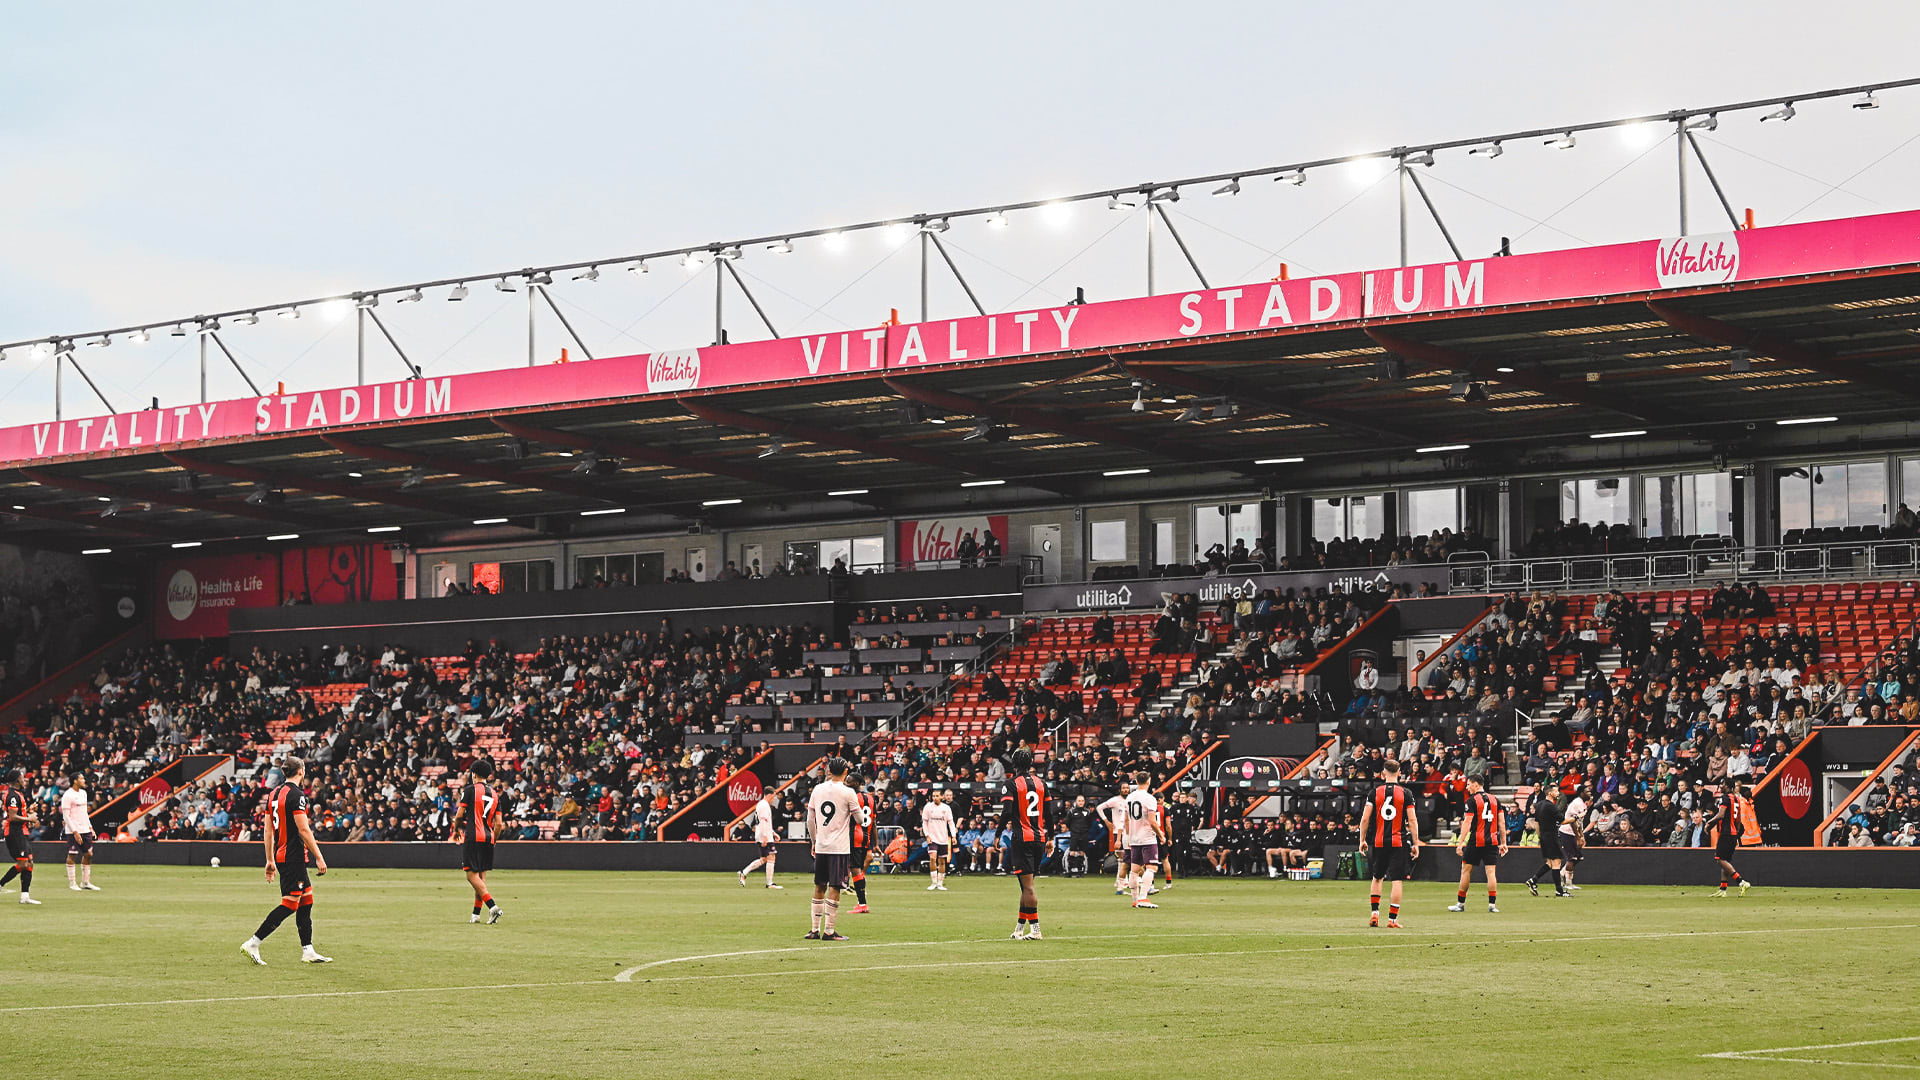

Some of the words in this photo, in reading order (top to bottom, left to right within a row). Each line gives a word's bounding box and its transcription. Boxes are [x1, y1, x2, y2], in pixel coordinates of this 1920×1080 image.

[1660, 237, 1736, 282] Vitality
[801, 308, 1080, 374] VITALITY
[1179, 261, 1485, 335] STADIUM
[650, 352, 698, 388] Vitality
[33, 404, 218, 455] VITALITY
[256, 378, 451, 431] STADIUM
[200, 579, 232, 594] Health
[234, 582, 241, 591] &
[243, 576, 263, 591] Life
[1199, 583, 1242, 601] utilita
[200, 596, 236, 608] insurance
[1076, 589, 1118, 607] utilita
[728, 781, 763, 802] Vitality
[1780, 773, 1812, 805] Vitality
[271, 800, 280, 830] 3
[481, 795, 495, 819] 7
[820, 800, 836, 827] 9
[1025, 790, 1040, 817] 2
[1127, 800, 1143, 821] 10
[1380, 795, 1397, 821] 6
[1481, 801, 1495, 823] 4
[1733, 802, 1739, 819] 5
[861, 805, 872, 828] 8
